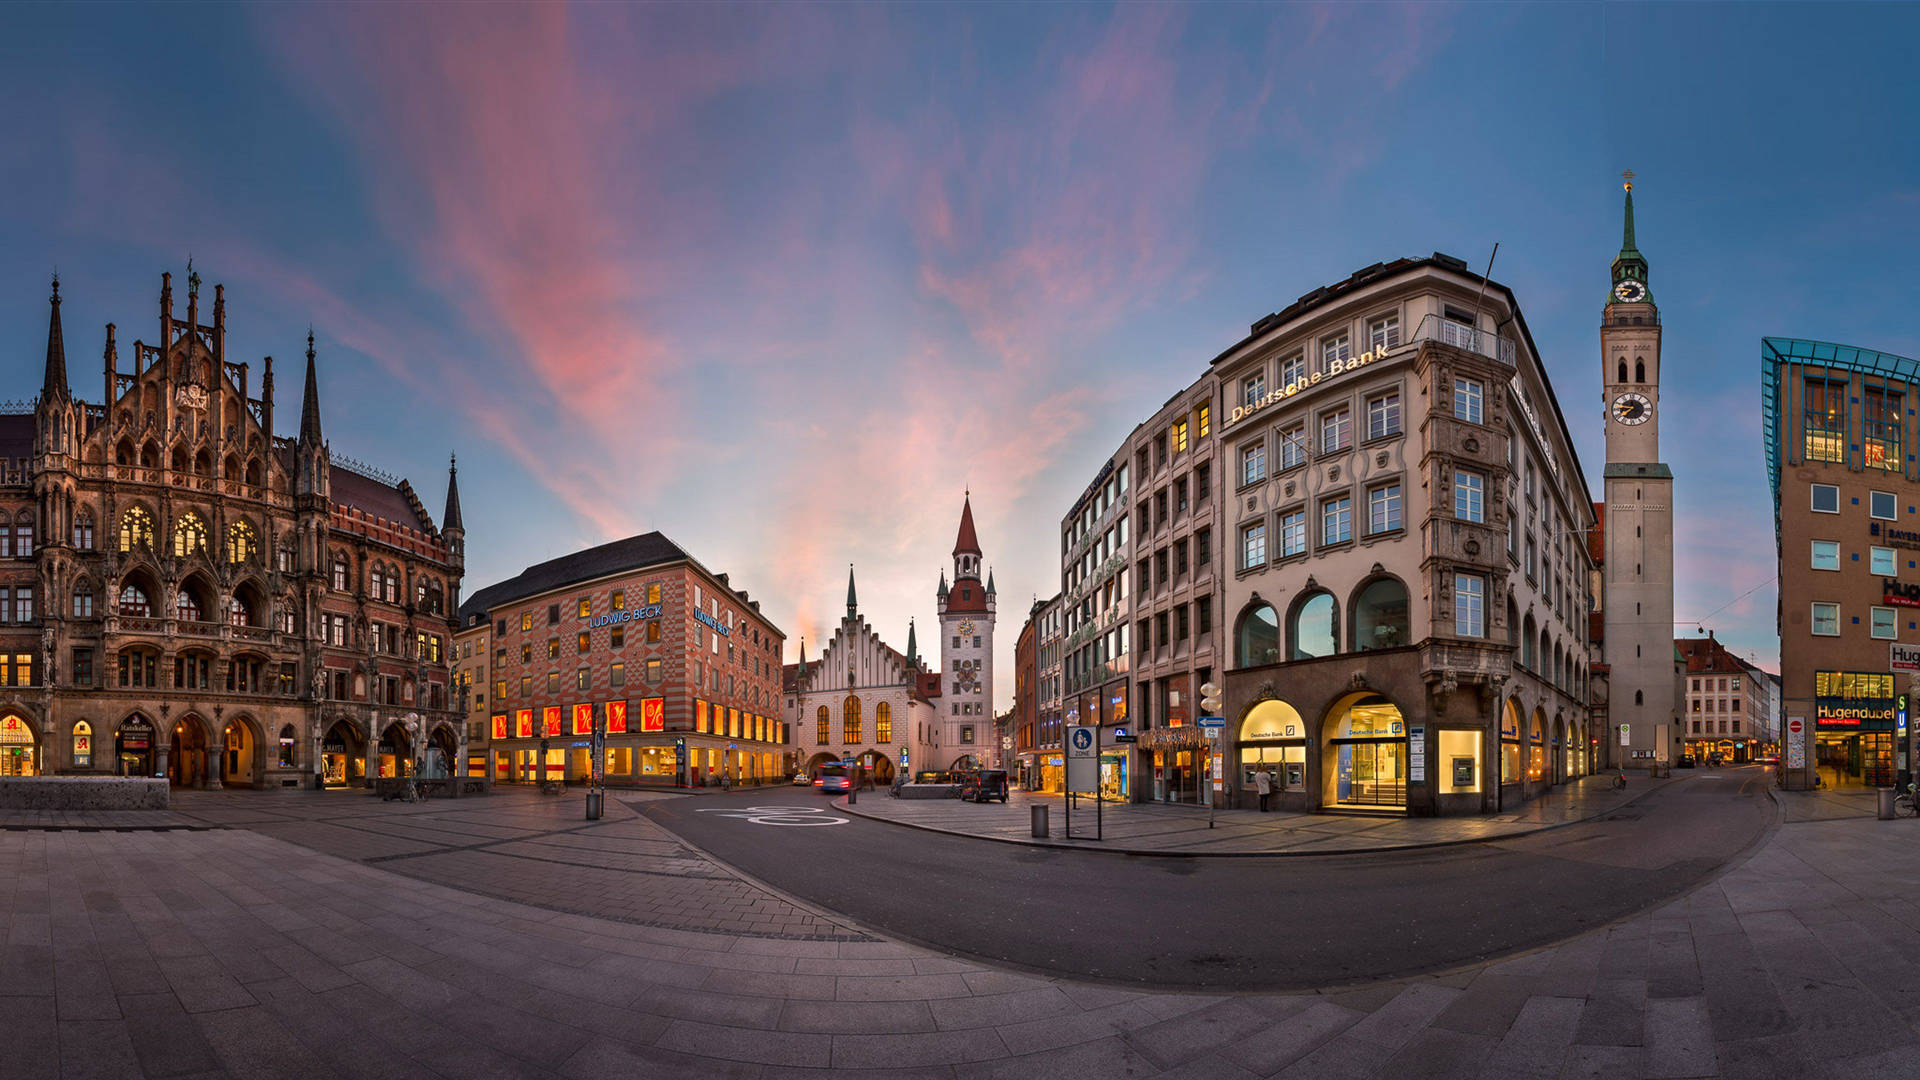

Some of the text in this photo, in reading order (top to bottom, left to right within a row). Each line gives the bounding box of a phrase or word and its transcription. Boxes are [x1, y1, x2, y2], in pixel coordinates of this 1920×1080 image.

[1231, 343, 1389, 423] Deutsche Bank
[588, 605, 662, 628] LUDWIG BECK
[1817, 705, 1894, 719] Hugendubel
[1898, 713, 1905, 726] U
